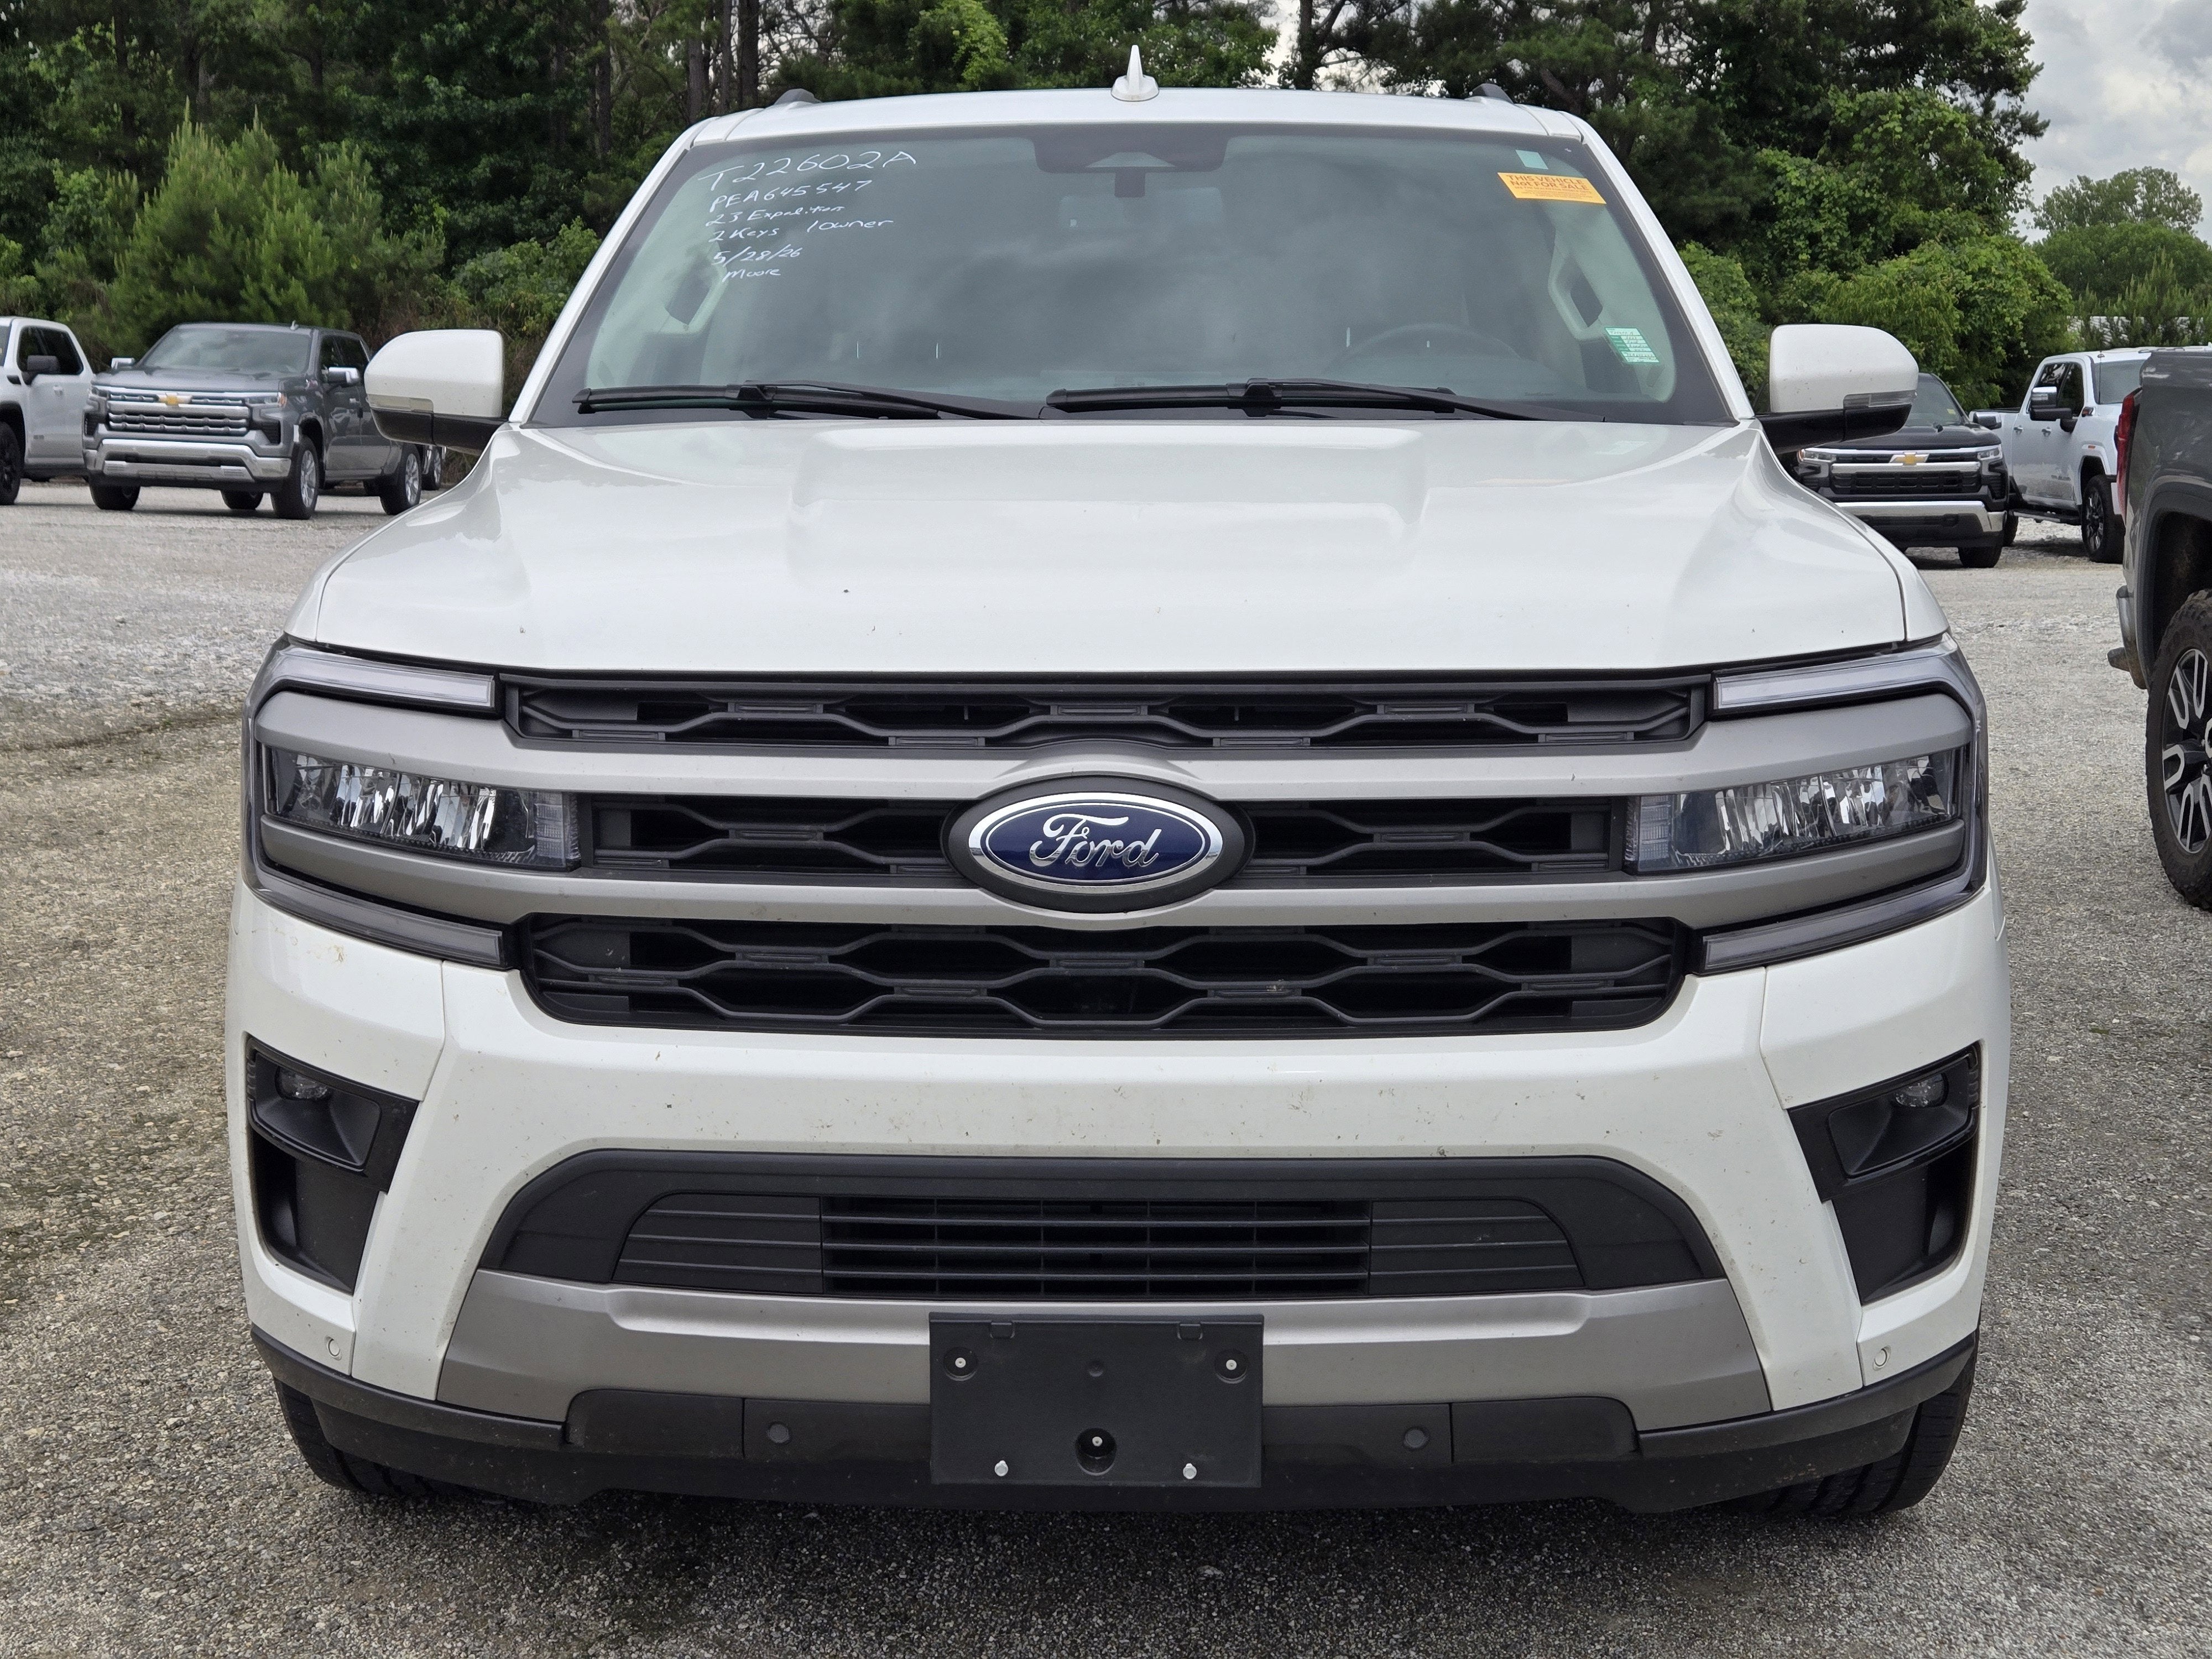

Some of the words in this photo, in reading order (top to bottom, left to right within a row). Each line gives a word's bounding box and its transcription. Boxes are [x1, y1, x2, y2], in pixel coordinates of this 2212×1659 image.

[698, 151, 916, 191] T22602A
[1536, 176, 1585, 185] VEHICLE
[705, 211, 743, 227] 23
[708, 230, 725, 242] 2
[729, 227, 780, 239] Keys
[711, 244, 803, 267] 5/28/26
[1030, 813, 1162, 867] Ford
